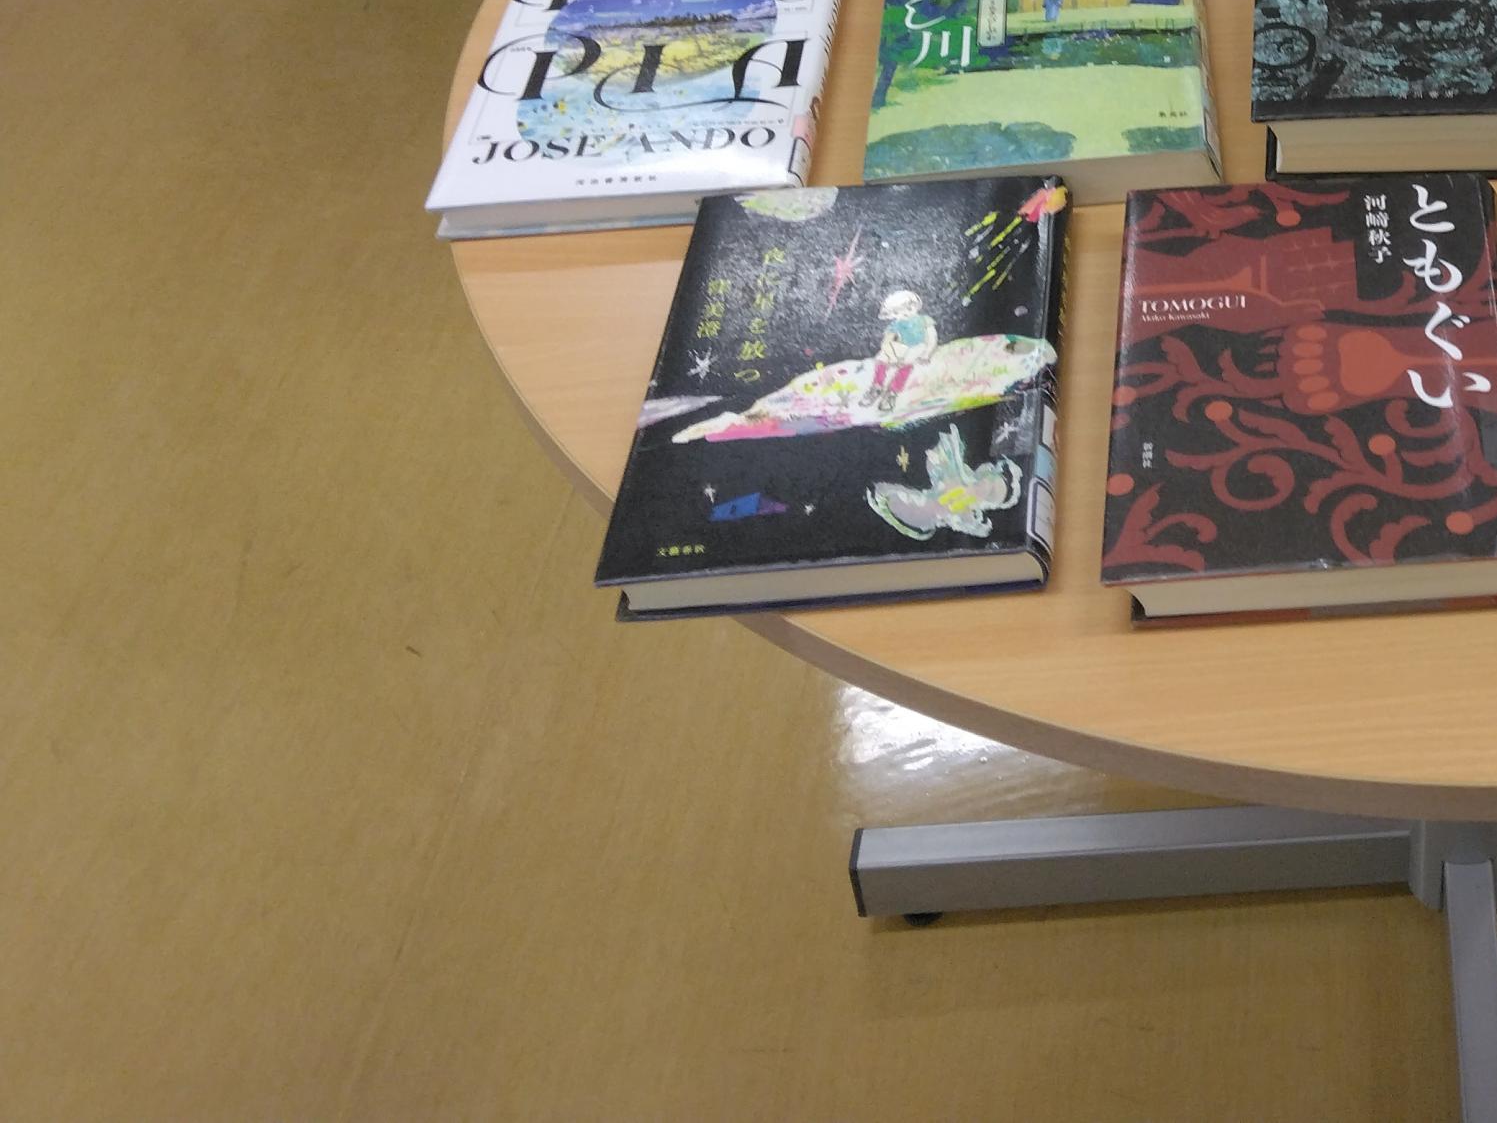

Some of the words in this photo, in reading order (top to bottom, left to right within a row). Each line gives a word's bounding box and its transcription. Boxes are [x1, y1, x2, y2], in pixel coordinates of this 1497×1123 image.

[472, 131, 602, 165] JOSE
[1139, 295, 1246, 314] TOMOGUI
[1403, 184, 1492, 409] ともぐい
